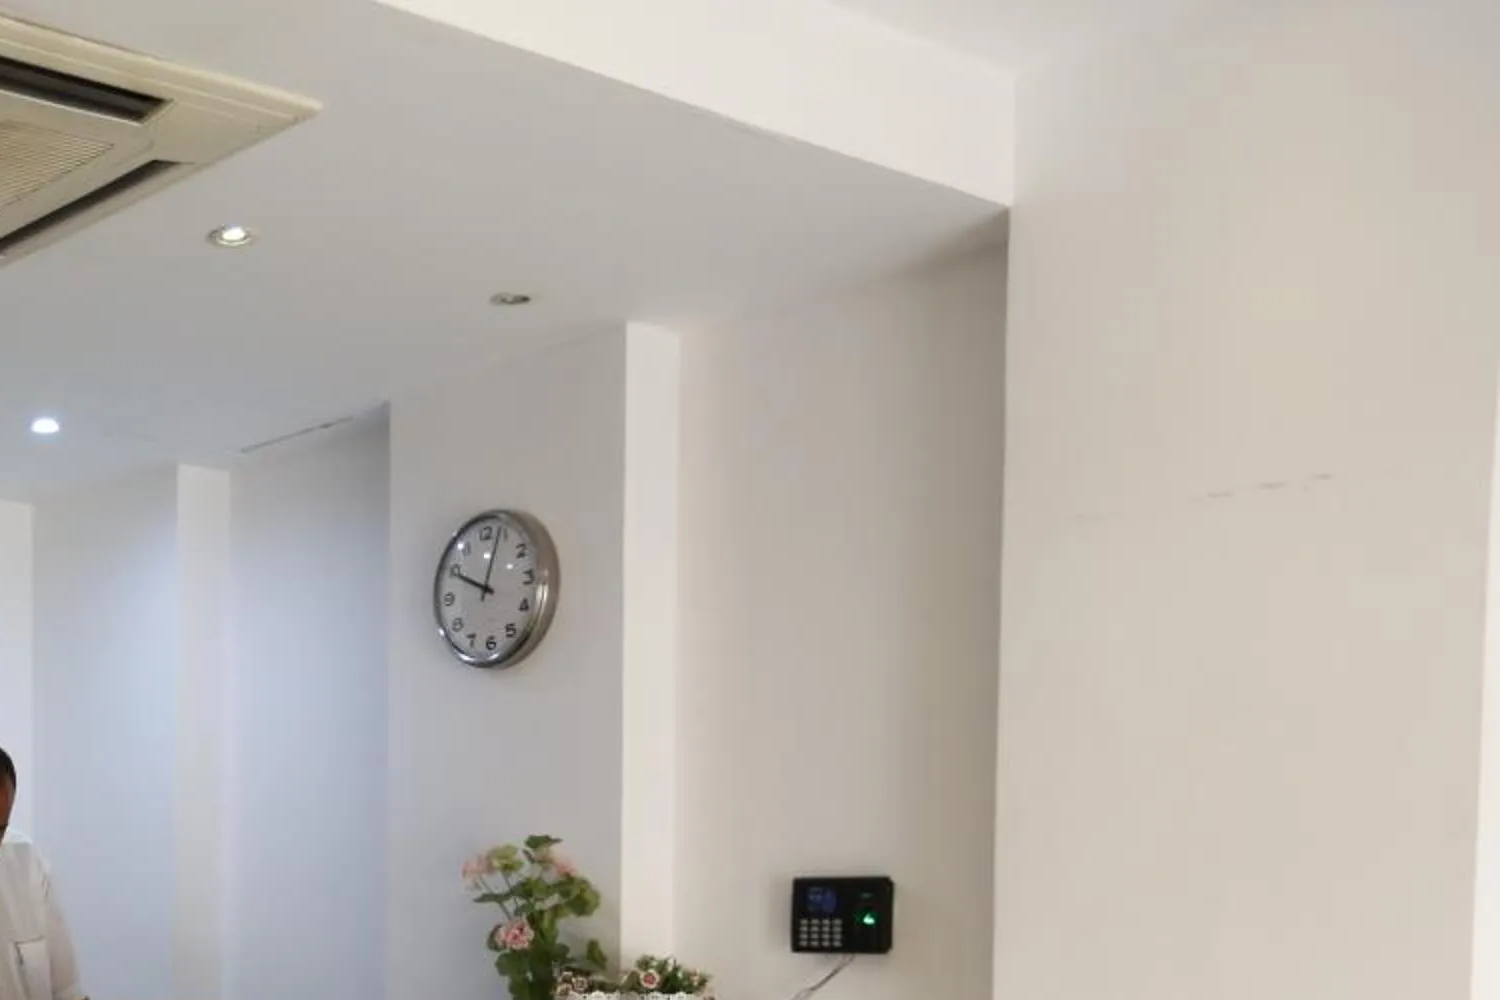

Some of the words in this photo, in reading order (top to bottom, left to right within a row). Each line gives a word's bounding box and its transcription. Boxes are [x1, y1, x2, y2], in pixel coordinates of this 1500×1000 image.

[479, 526, 493, 541] 12
[516, 543, 528, 559] 2
[523, 569, 534, 585] 3
[444, 592, 455, 607] 9
[519, 598, 529, 612] 4
[452, 617, 464, 632] 8
[505, 623, 516, 638] 5
[467, 633, 477, 648] 7
[486, 636, 497, 651] 6
